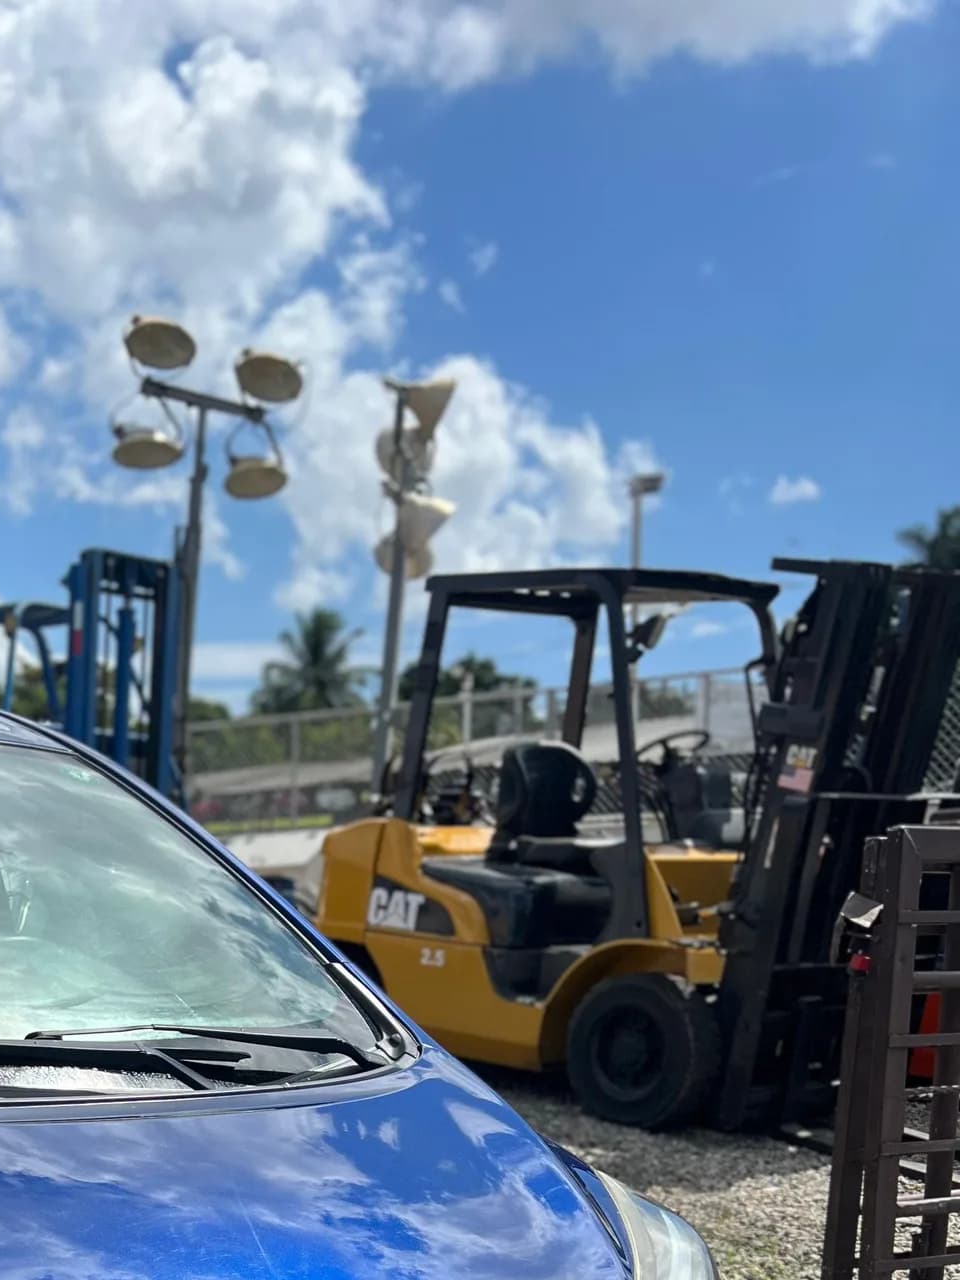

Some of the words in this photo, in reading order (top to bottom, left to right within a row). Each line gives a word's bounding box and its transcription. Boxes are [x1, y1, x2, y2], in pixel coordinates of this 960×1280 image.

[786, 744, 818, 768] CAT
[368, 887, 426, 931] CAT
[420, 947, 445, 967] 2.5
